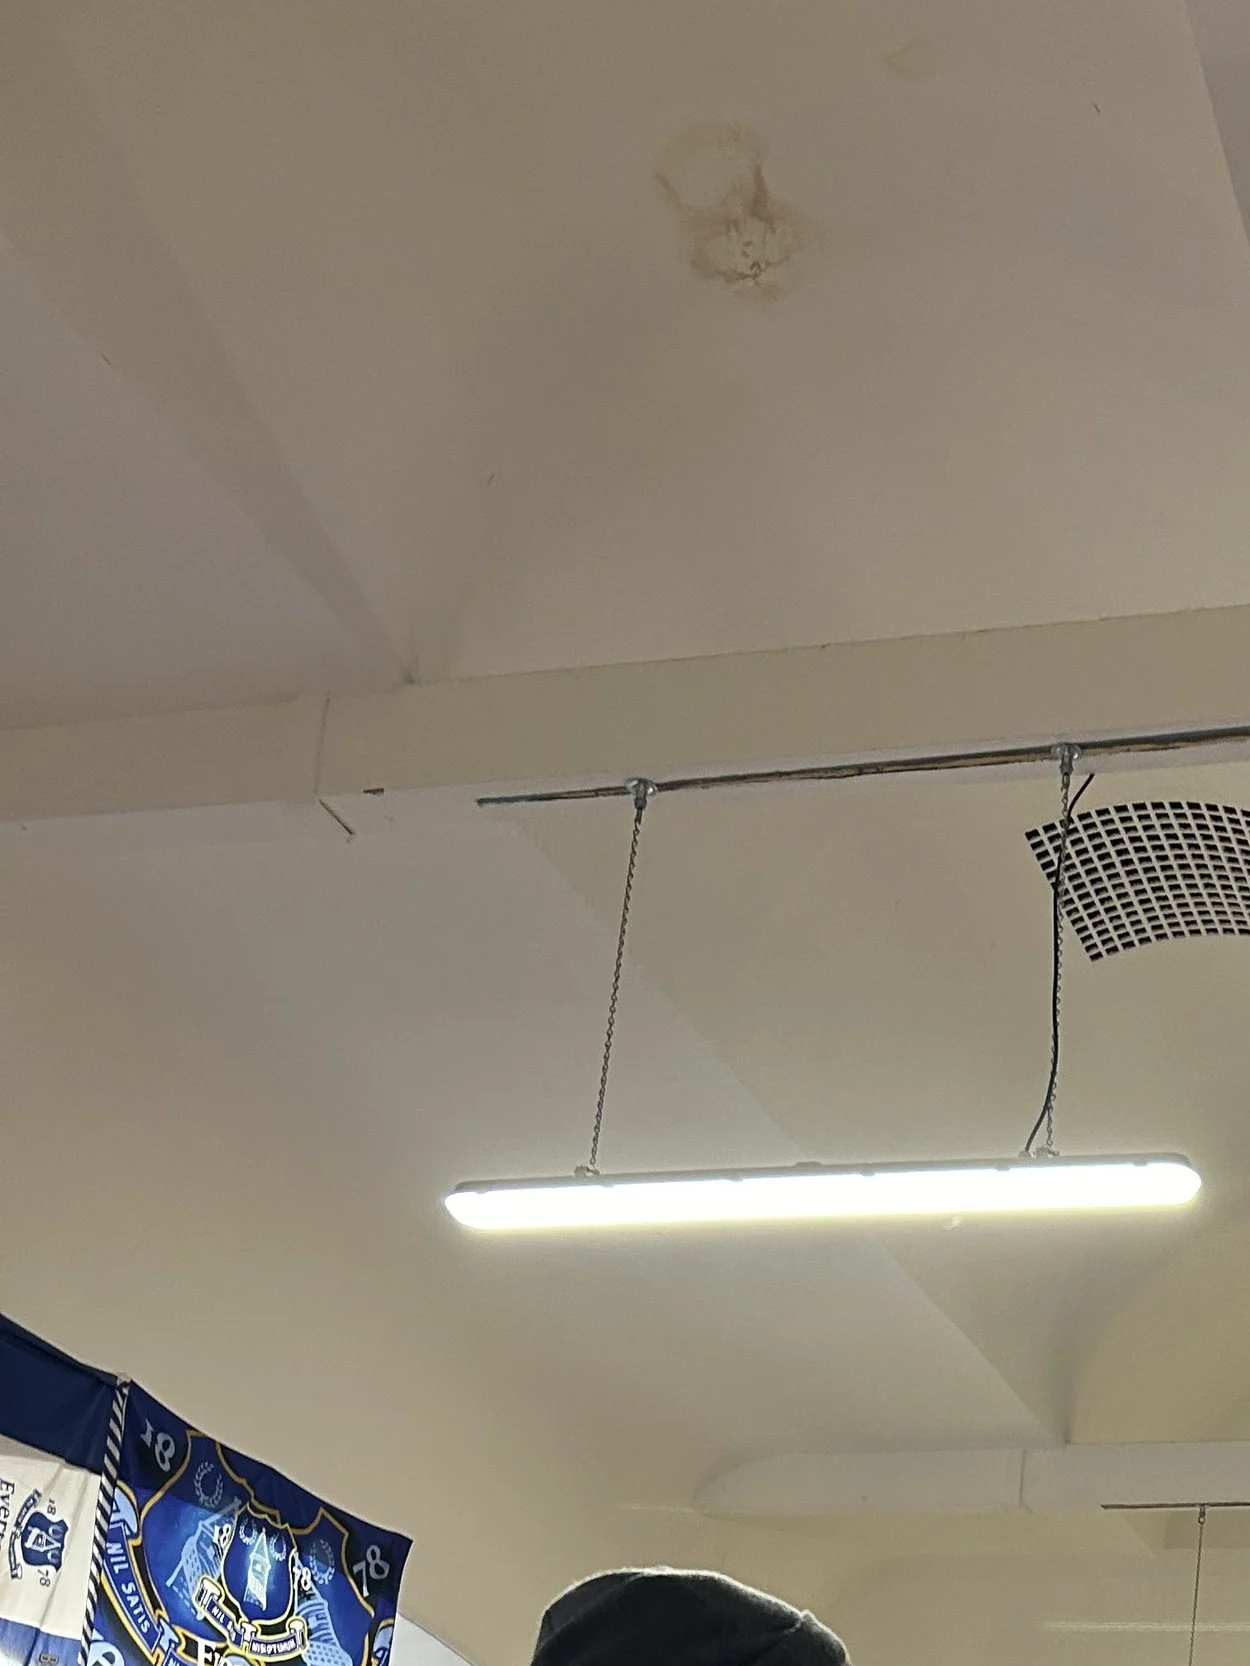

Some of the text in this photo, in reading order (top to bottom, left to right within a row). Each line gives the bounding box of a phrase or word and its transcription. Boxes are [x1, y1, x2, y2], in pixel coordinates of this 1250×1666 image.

[105, 1542, 151, 1634] NIL SATIS
[352, 1543, 391, 1597] 78
